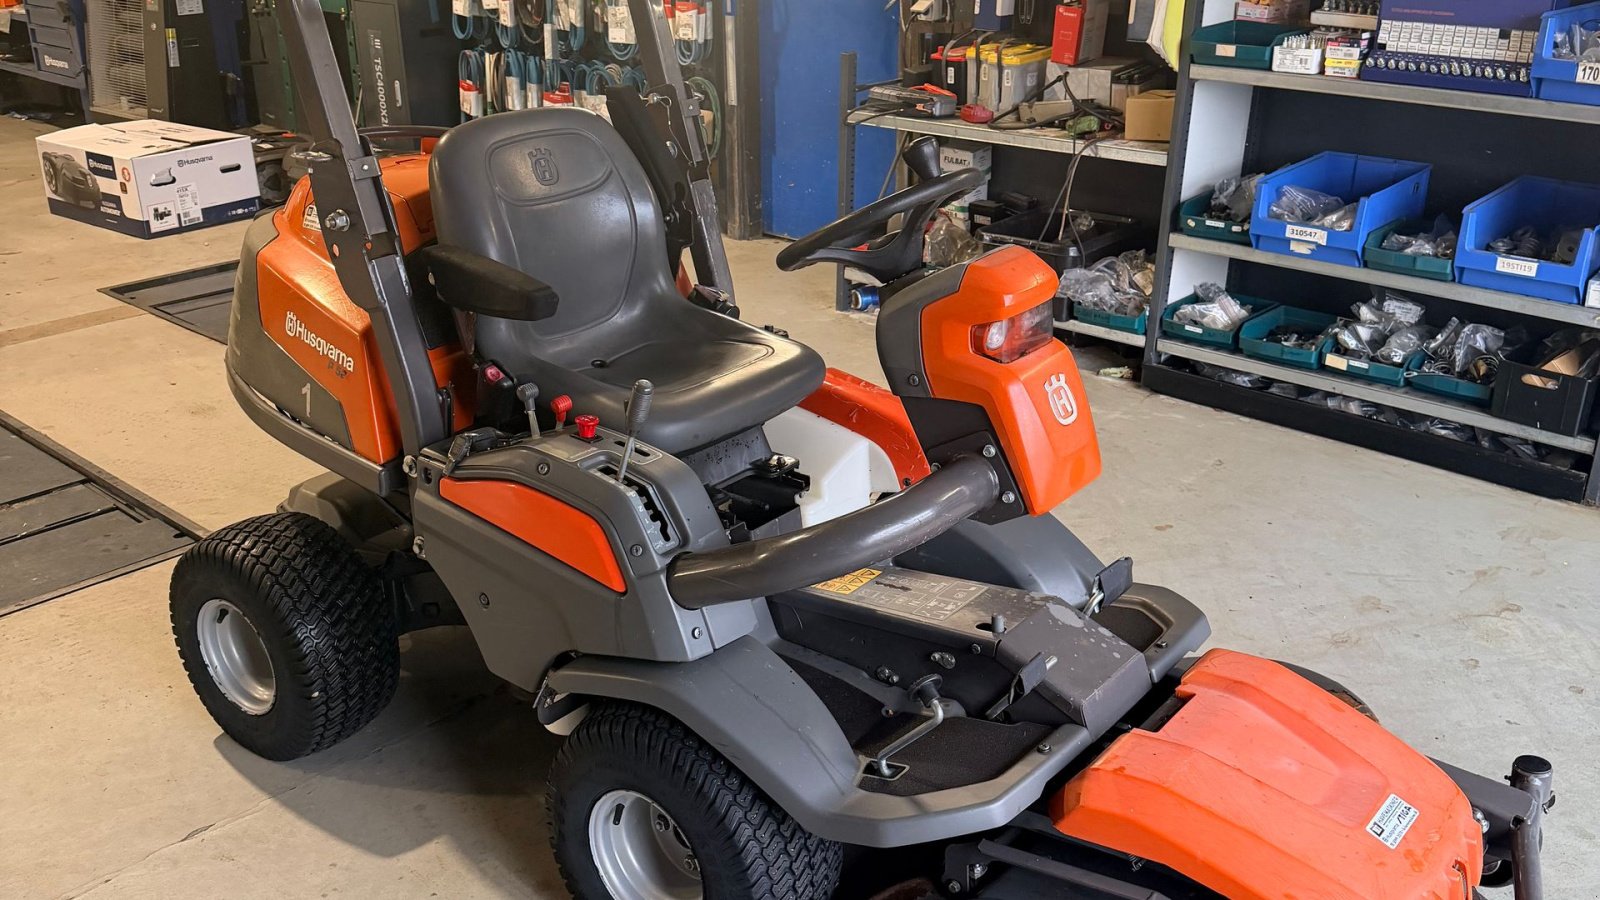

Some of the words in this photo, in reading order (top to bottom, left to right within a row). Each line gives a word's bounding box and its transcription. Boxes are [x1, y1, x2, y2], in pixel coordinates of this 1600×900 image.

[1581, 65, 1600, 81] 170
[184, 155, 213, 166] Husqvarna
[1290, 228, 1318, 239] 310547
[296, 319, 354, 372] Husqvarna
[301, 382, 312, 418] 1
